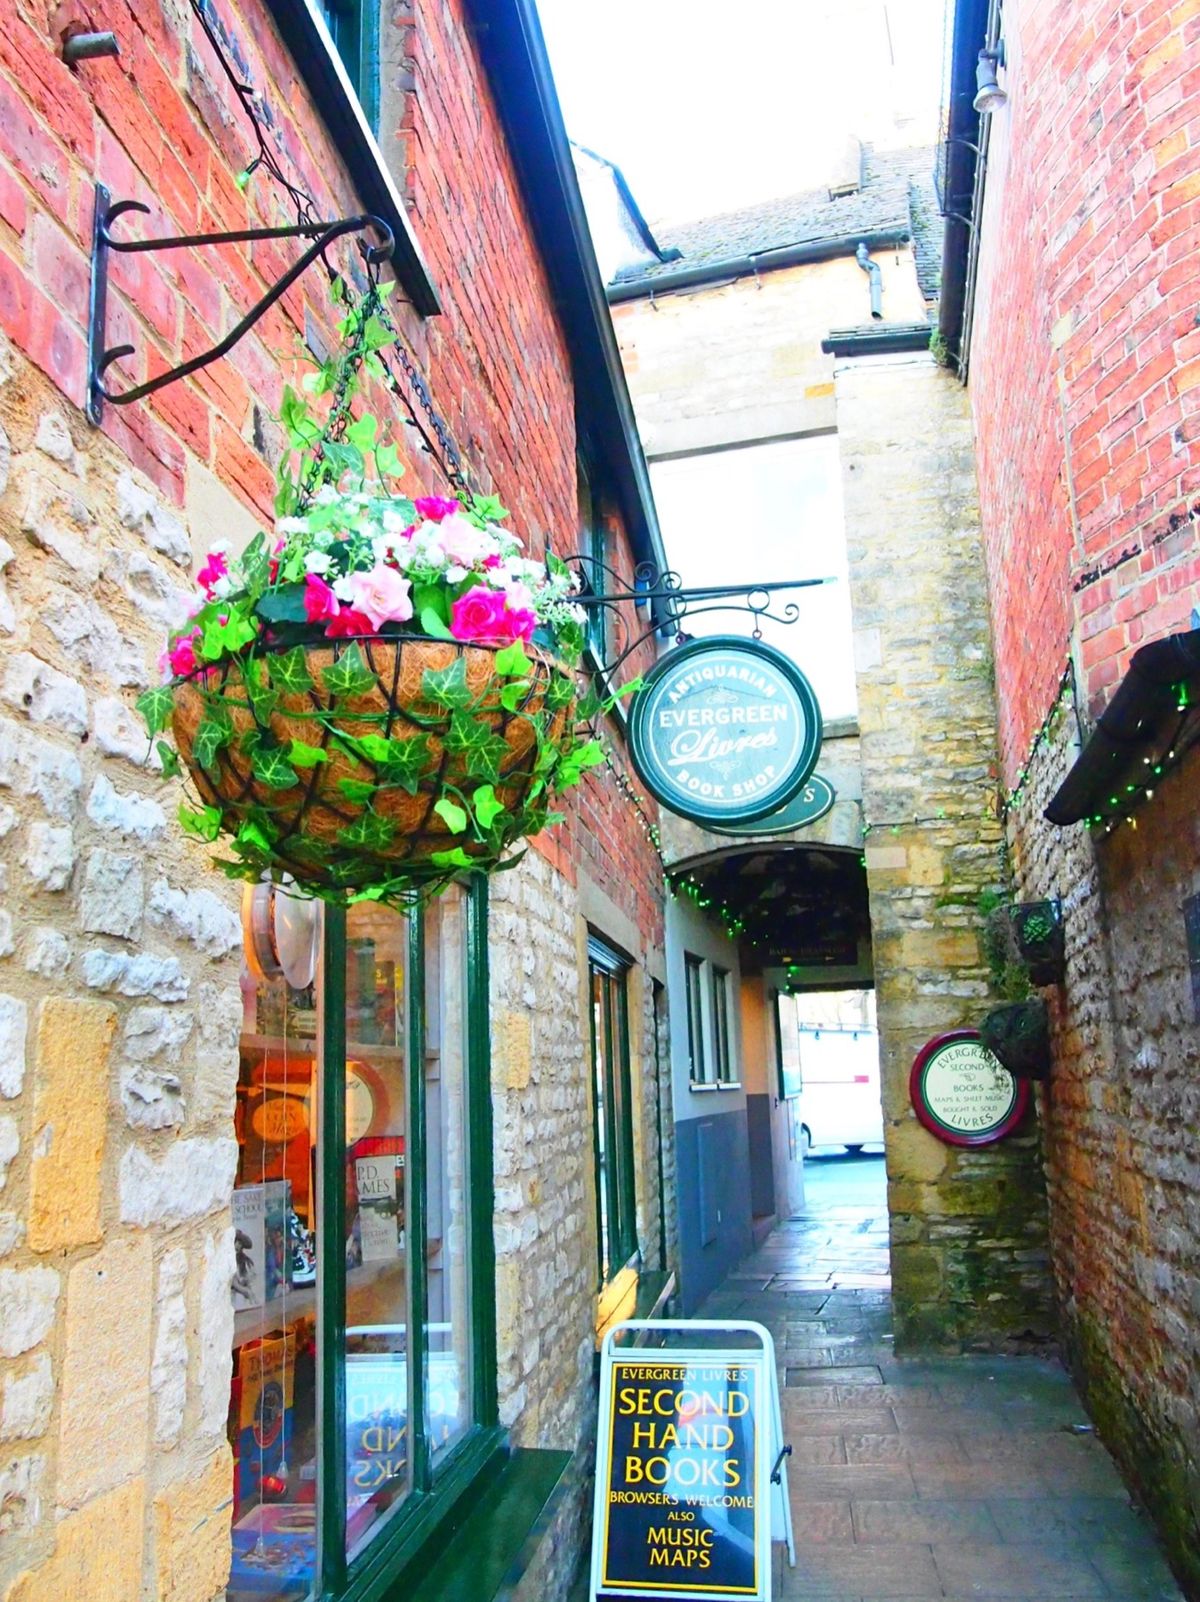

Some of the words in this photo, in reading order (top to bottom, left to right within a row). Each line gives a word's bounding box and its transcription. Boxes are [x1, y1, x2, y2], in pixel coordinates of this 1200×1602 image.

[668, 665, 777, 704] ANTIQUARIAN
[658, 703, 788, 728] EVERGREEN
[667, 726, 778, 766] Livres
[676, 769, 725, 798] BOOK
[732, 765, 777, 797] SHOP
[937, 1047, 1000, 1069] EVERGREN
[951, 1112, 994, 1127] LIVRES
[622, 1367, 697, 1381] EVERGREEN
[702, 1368, 749, 1382] LIVRES
[618, 1388, 750, 1418] SECOND
[632, 1421, 735, 1451] HAND
[625, 1455, 741, 1488] BOOKS
[610, 1490, 679, 1506] BROWSERS
[686, 1494, 755, 1509] WELCOME
[667, 1511, 695, 1521] ALSO
[647, 1526, 715, 1548] MUSIC
[649, 1548, 711, 1568] MAPS
